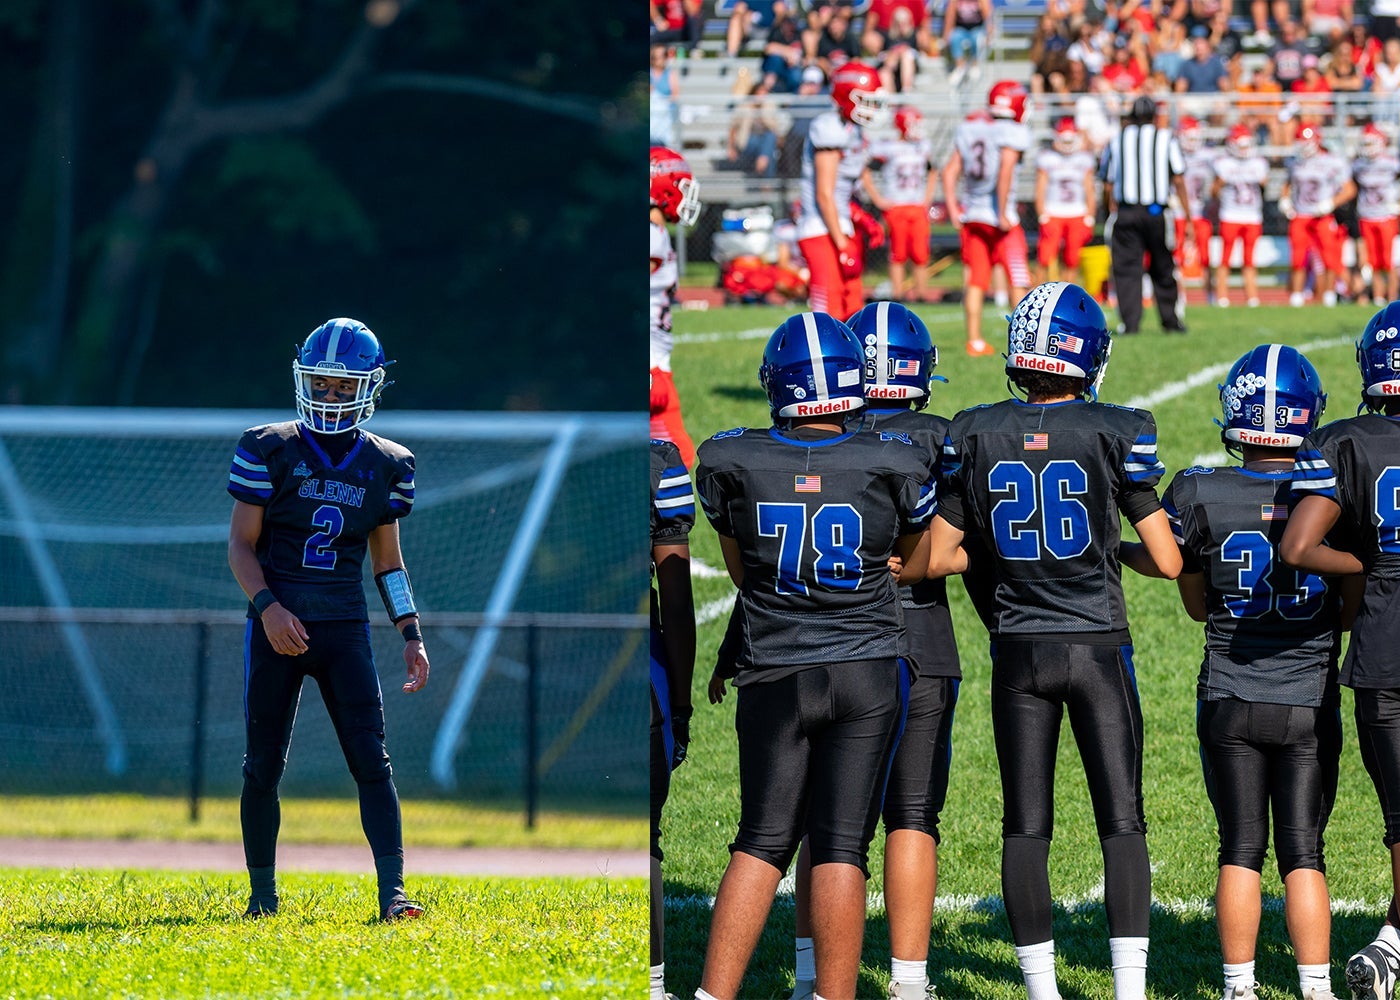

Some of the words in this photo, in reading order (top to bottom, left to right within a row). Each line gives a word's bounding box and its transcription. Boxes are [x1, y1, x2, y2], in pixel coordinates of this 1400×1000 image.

[971, 139, 986, 181] 3
[1023, 331, 1061, 357] 26
[865, 357, 896, 380] 61
[1015, 355, 1066, 374] Riddell
[865, 387, 908, 399] ddell
[797, 399, 851, 416] Riddell
[1251, 404, 1289, 429] 33
[1239, 431, 1291, 445] Riddell
[298, 478, 366, 508] GLENN
[988, 459, 1092, 561] 26
[302, 504, 345, 570] 2
[756, 502, 865, 597] 78
